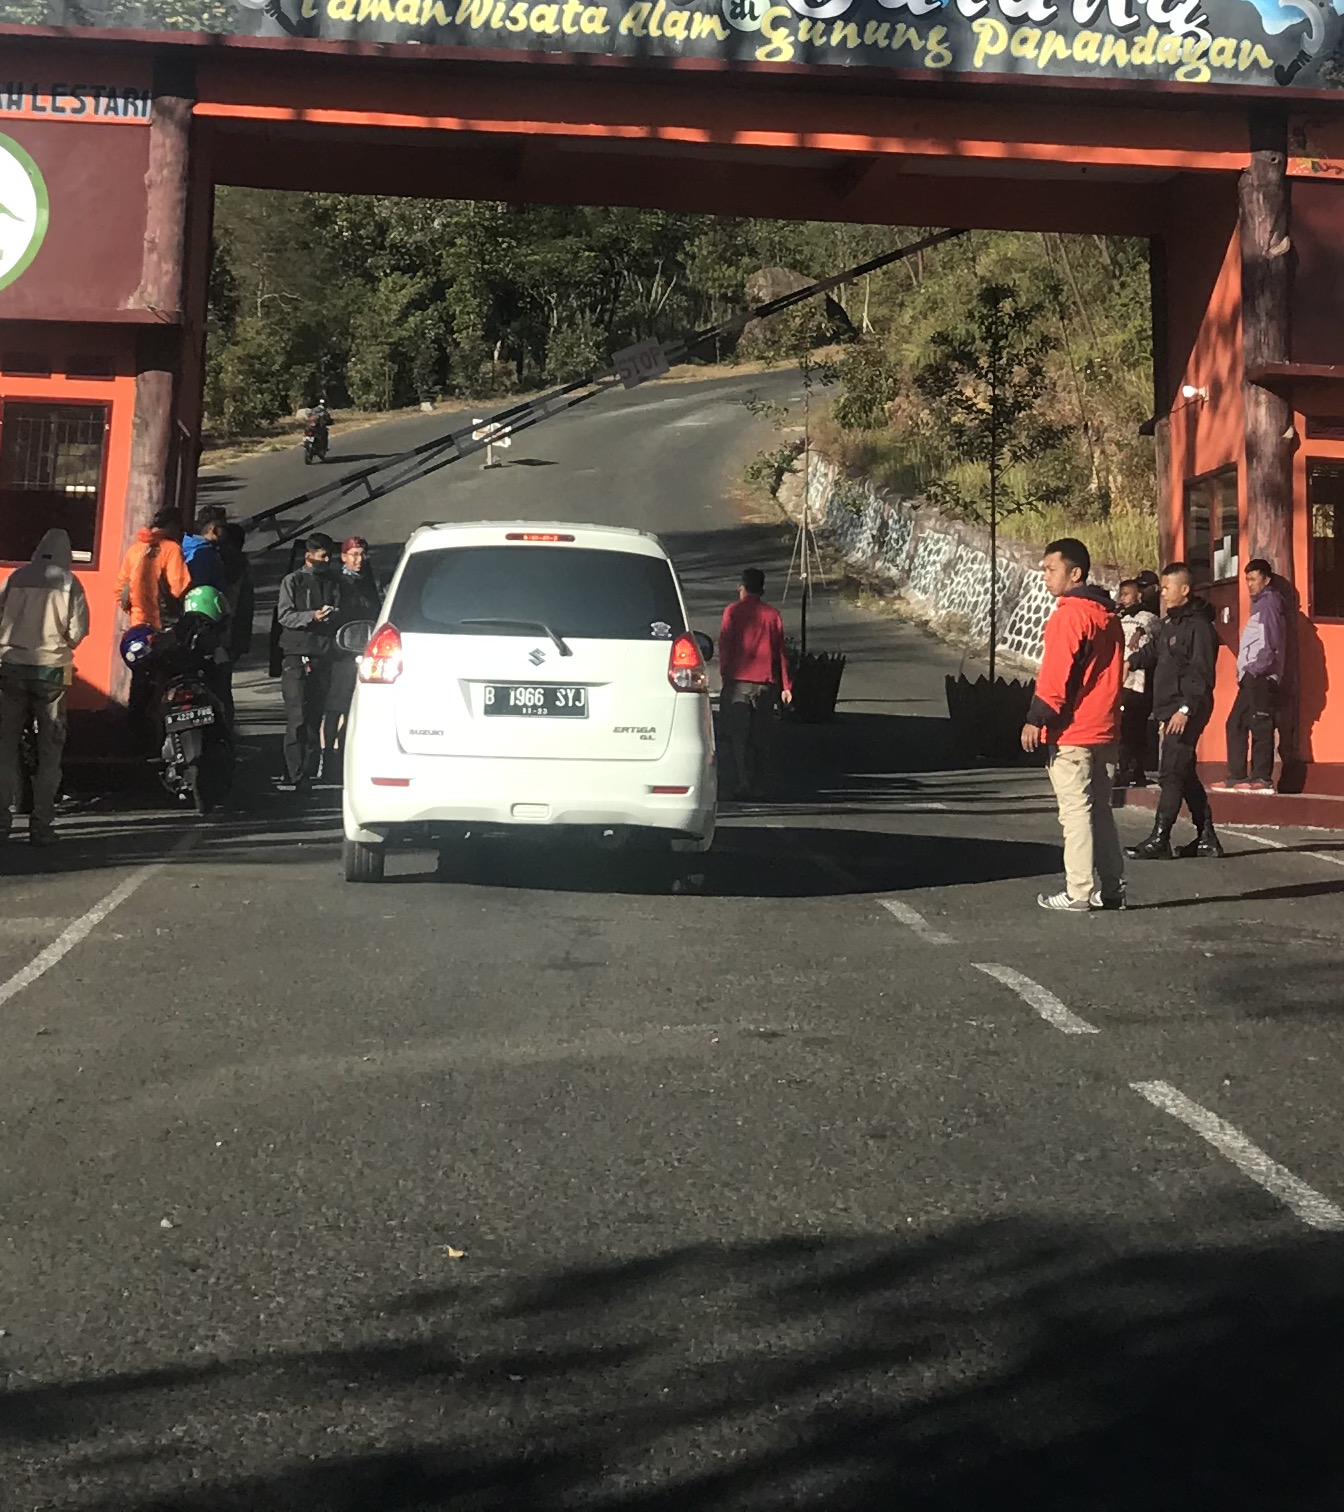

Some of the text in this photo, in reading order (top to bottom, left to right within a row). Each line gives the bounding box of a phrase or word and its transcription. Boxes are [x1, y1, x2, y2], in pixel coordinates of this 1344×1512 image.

[620, 2, 730, 41] Alam
[756, 6, 953, 68] Gunung
[971, 18, 1274, 82] Papandayan
[31, 82, 152, 118] LESTARI
[485, 687, 585, 707] B 1966 SYJ
[612, 726, 657, 735] ERTIGA
